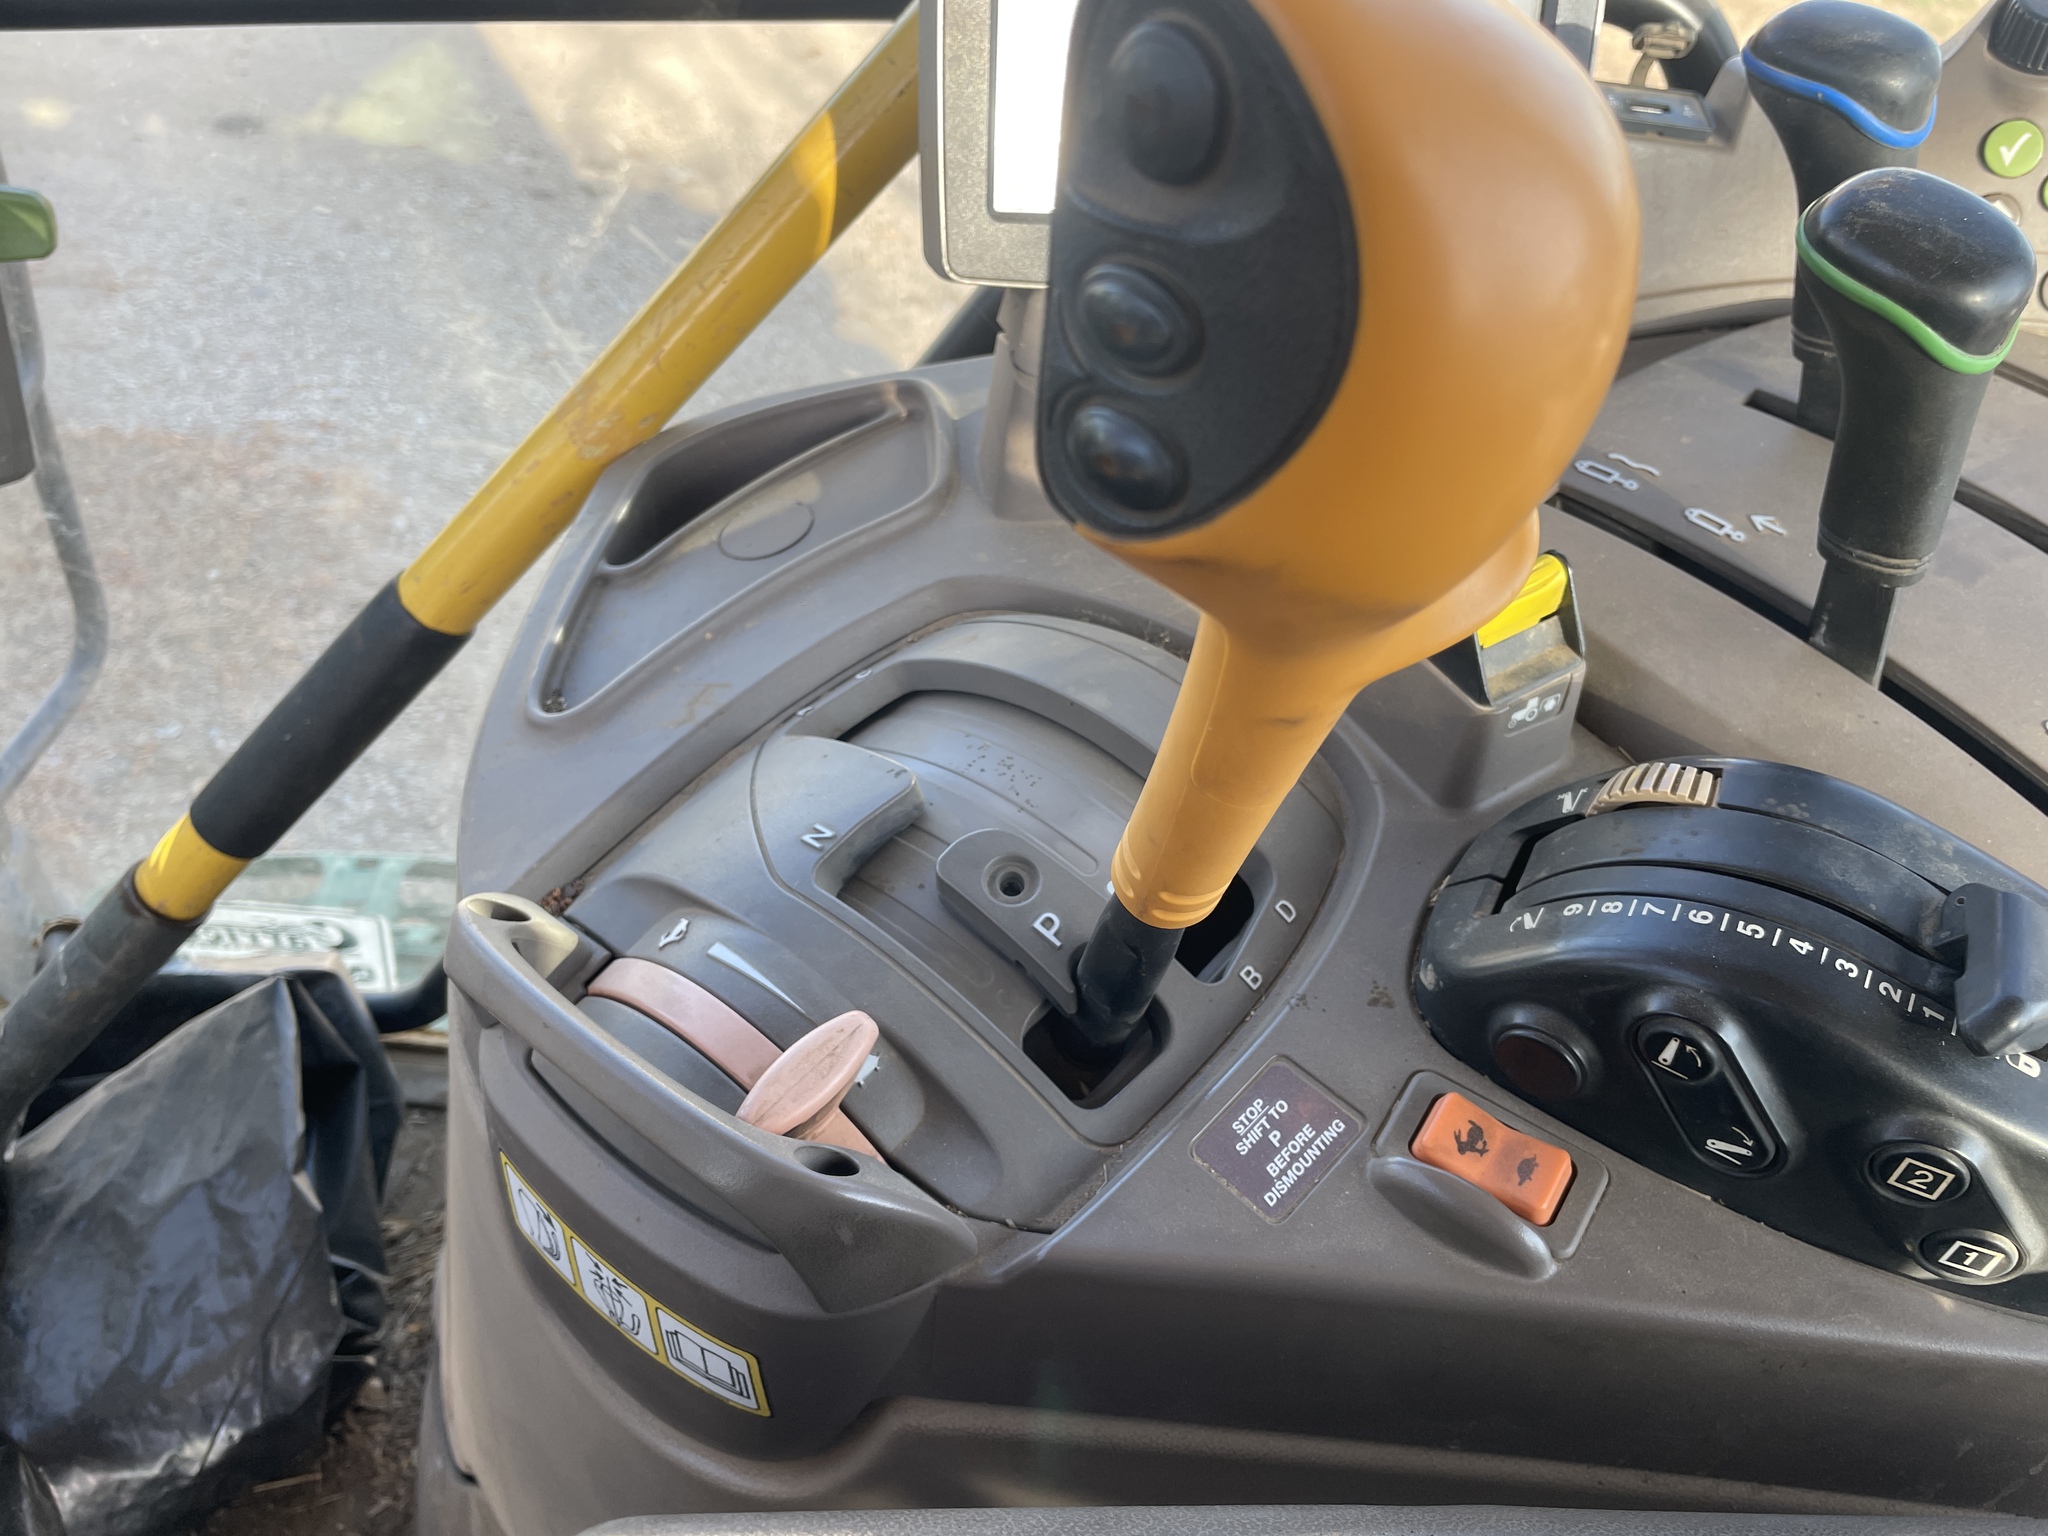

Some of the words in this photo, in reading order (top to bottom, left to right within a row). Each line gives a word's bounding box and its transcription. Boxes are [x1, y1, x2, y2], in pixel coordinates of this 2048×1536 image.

[801, 823, 836, 849] N
[1275, 899, 1297, 924] D
[1032, 912, 1062, 947] P
[1601, 901, 1623, 914] 8
[1642, 902, 1665, 916] 7
[1688, 909, 1714, 925] 6
[1736, 920, 1765, 940] 5
[1789, 937, 1814, 956] 4
[1835, 958, 1859, 979] 3
[1878, 981, 1902, 1004] 2
[1923, 1005, 1945, 1022] 1
[1239, 965, 1263, 991] B
[1232, 1098, 1264, 1134] STOP
[1235, 1116, 1272, 1155] SHIFT
[1268, 1100, 1288, 1120] TO
[1265, 1123, 1317, 1178] BEFORE
[1268, 1130, 1281, 1147] P
[1263, 1118, 1346, 1207] DISMOUNTING
[1907, 1170, 1934, 1190] 2
[1963, 1252, 1979, 1266] 1
